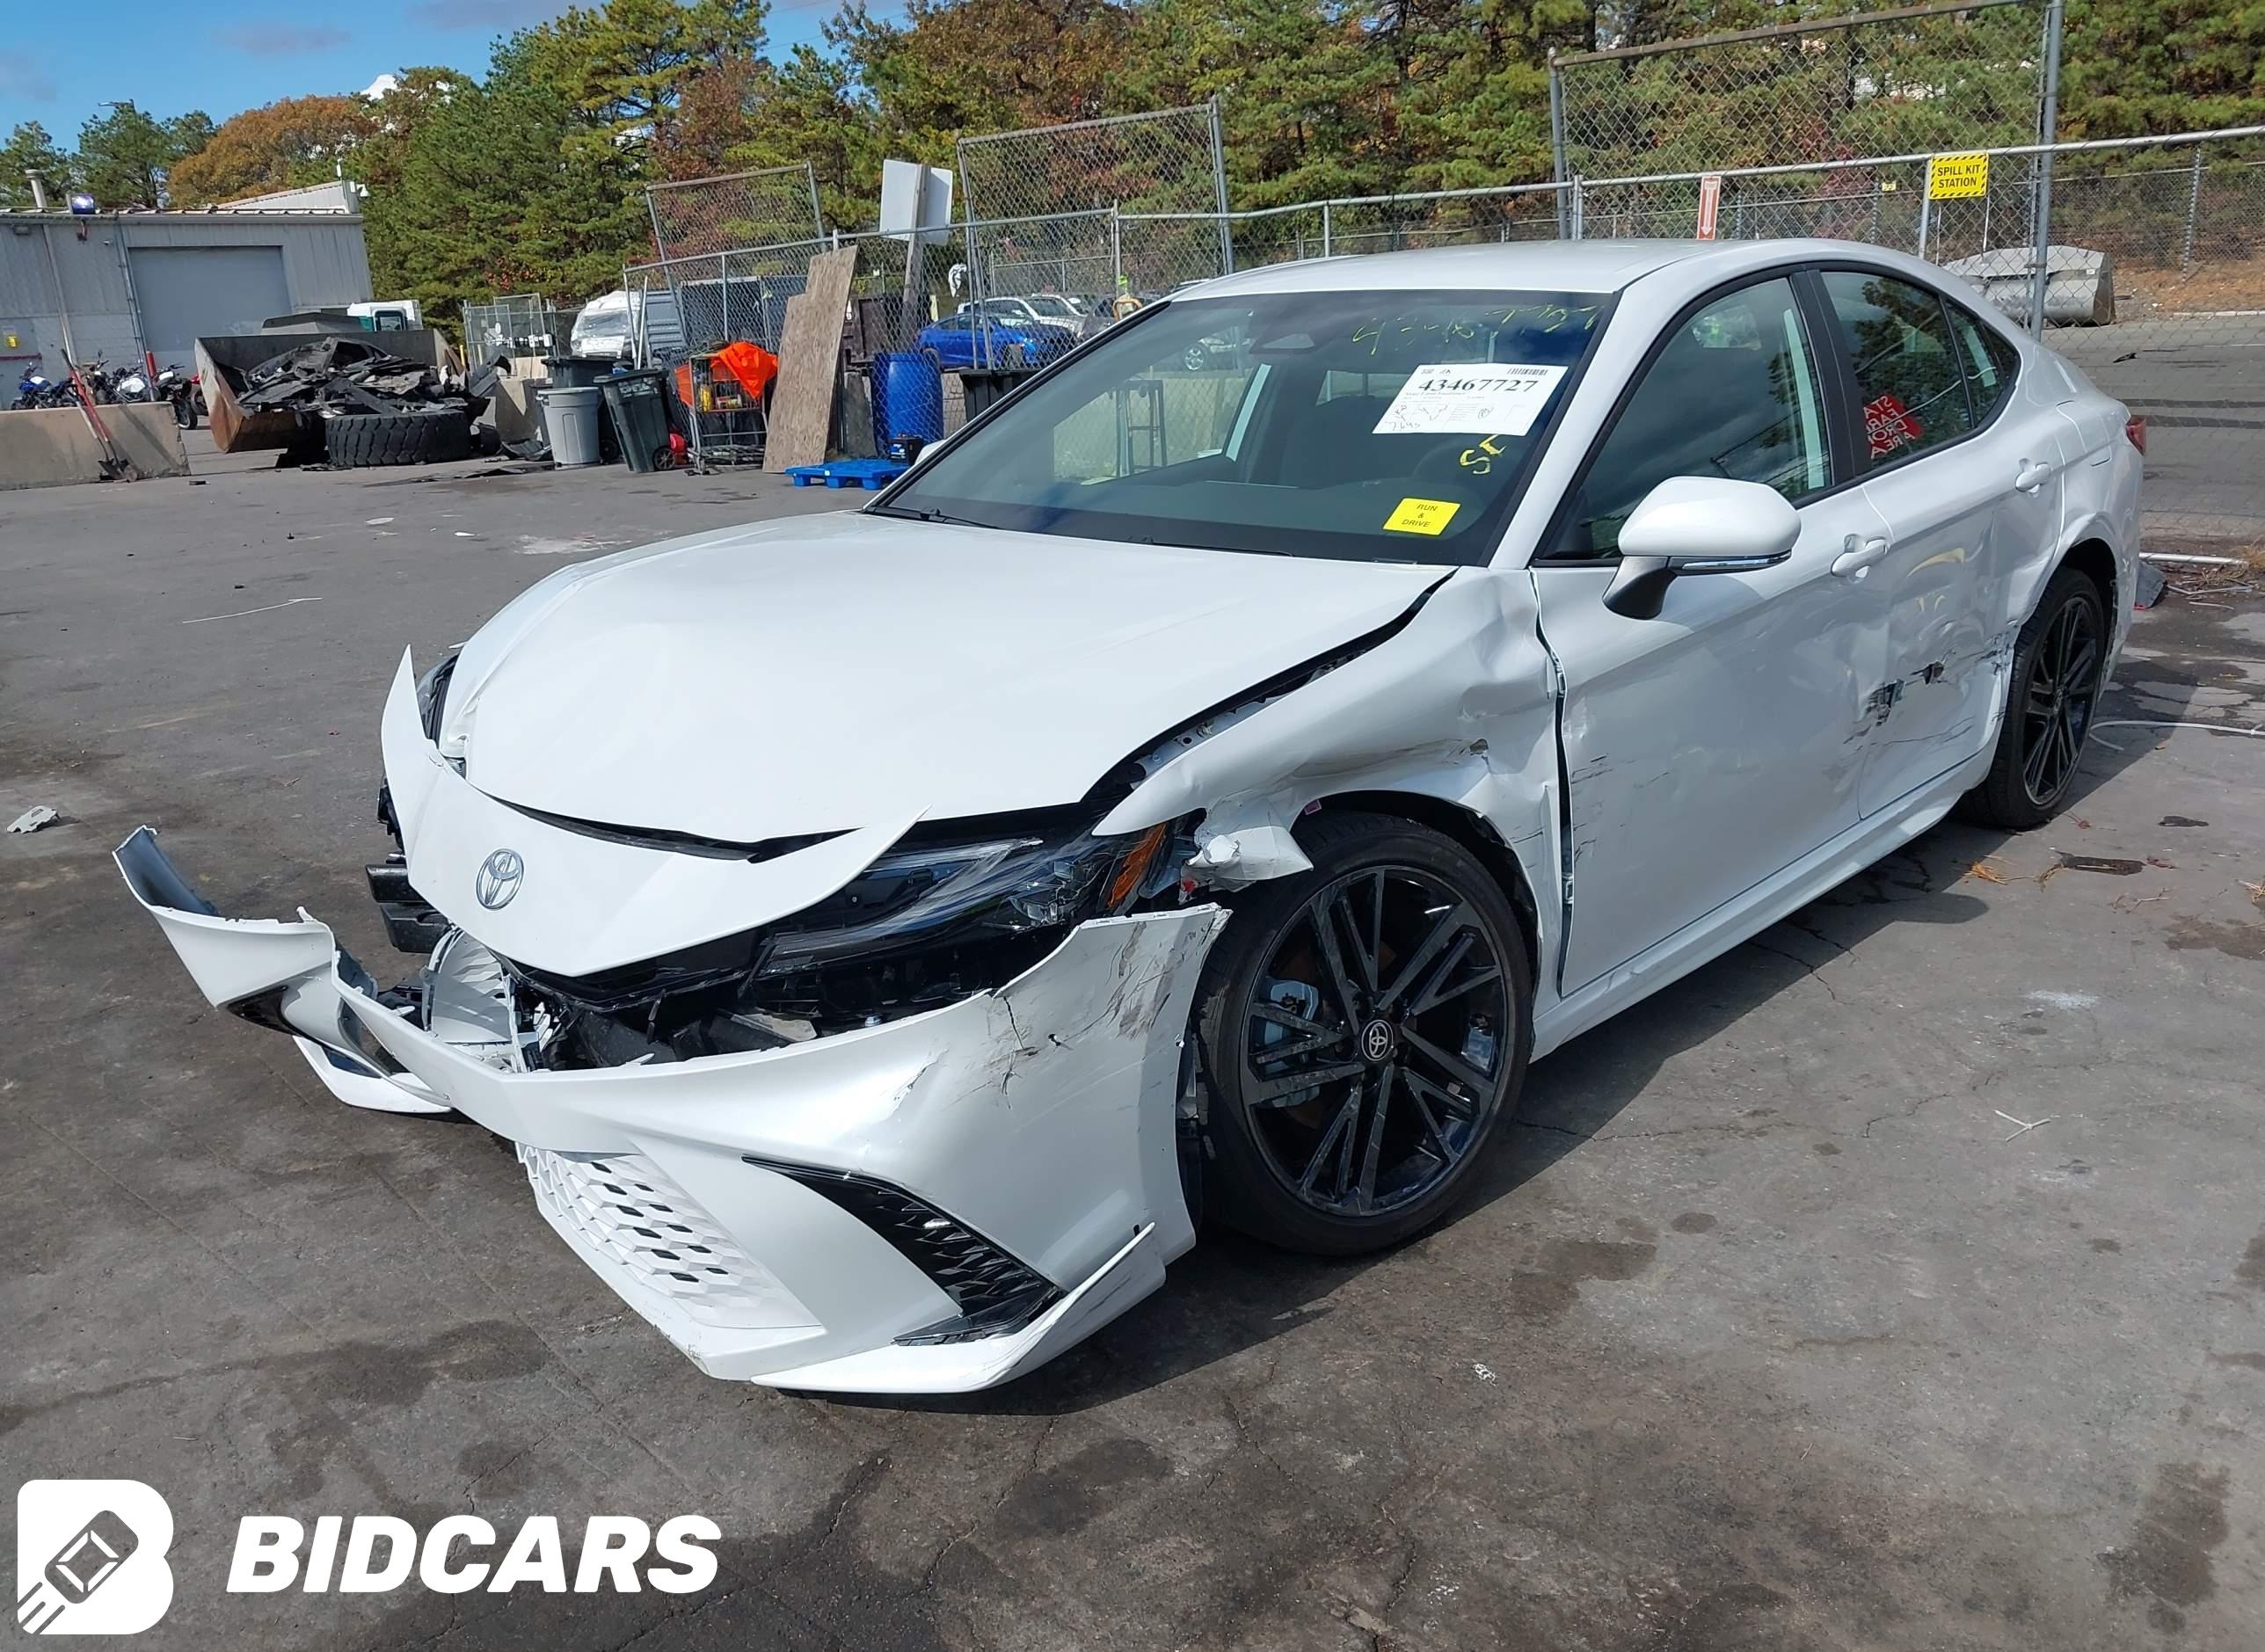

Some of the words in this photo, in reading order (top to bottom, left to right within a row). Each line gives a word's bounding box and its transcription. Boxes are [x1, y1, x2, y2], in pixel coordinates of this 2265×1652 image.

[1937, 165, 1963, 176] SPILL
[1965, 164, 1980, 174] KIT
[1939, 177, 1977, 188] STATION
[1418, 378, 1539, 392] 43467727
[1402, 519, 1431, 528] DRIVE
